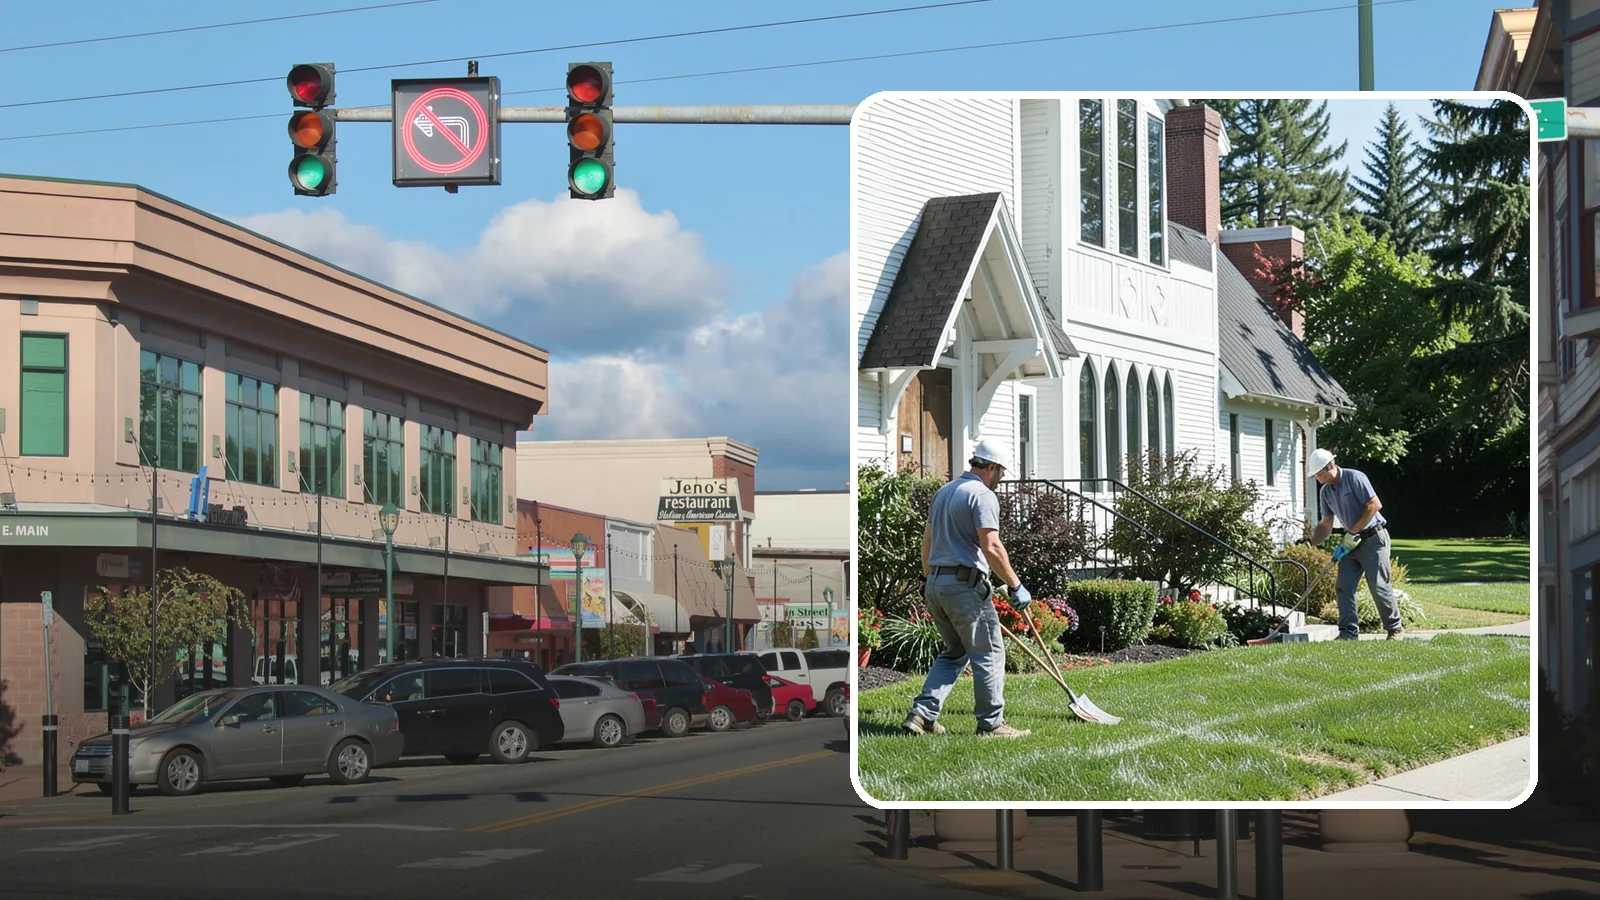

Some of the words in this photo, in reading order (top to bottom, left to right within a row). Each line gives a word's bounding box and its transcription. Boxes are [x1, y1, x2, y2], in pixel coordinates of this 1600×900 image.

[670, 480, 727, 494] Jeno's
[665, 496, 730, 508] restaurant
[658, 510, 681, 519] Italian
[686, 510, 714, 519] American
[714, 509, 738, 518] Cuisine
[2, 525, 13, 536] E.
[16, 525, 49, 536] MAIN
[797, 608, 828, 616] Street
